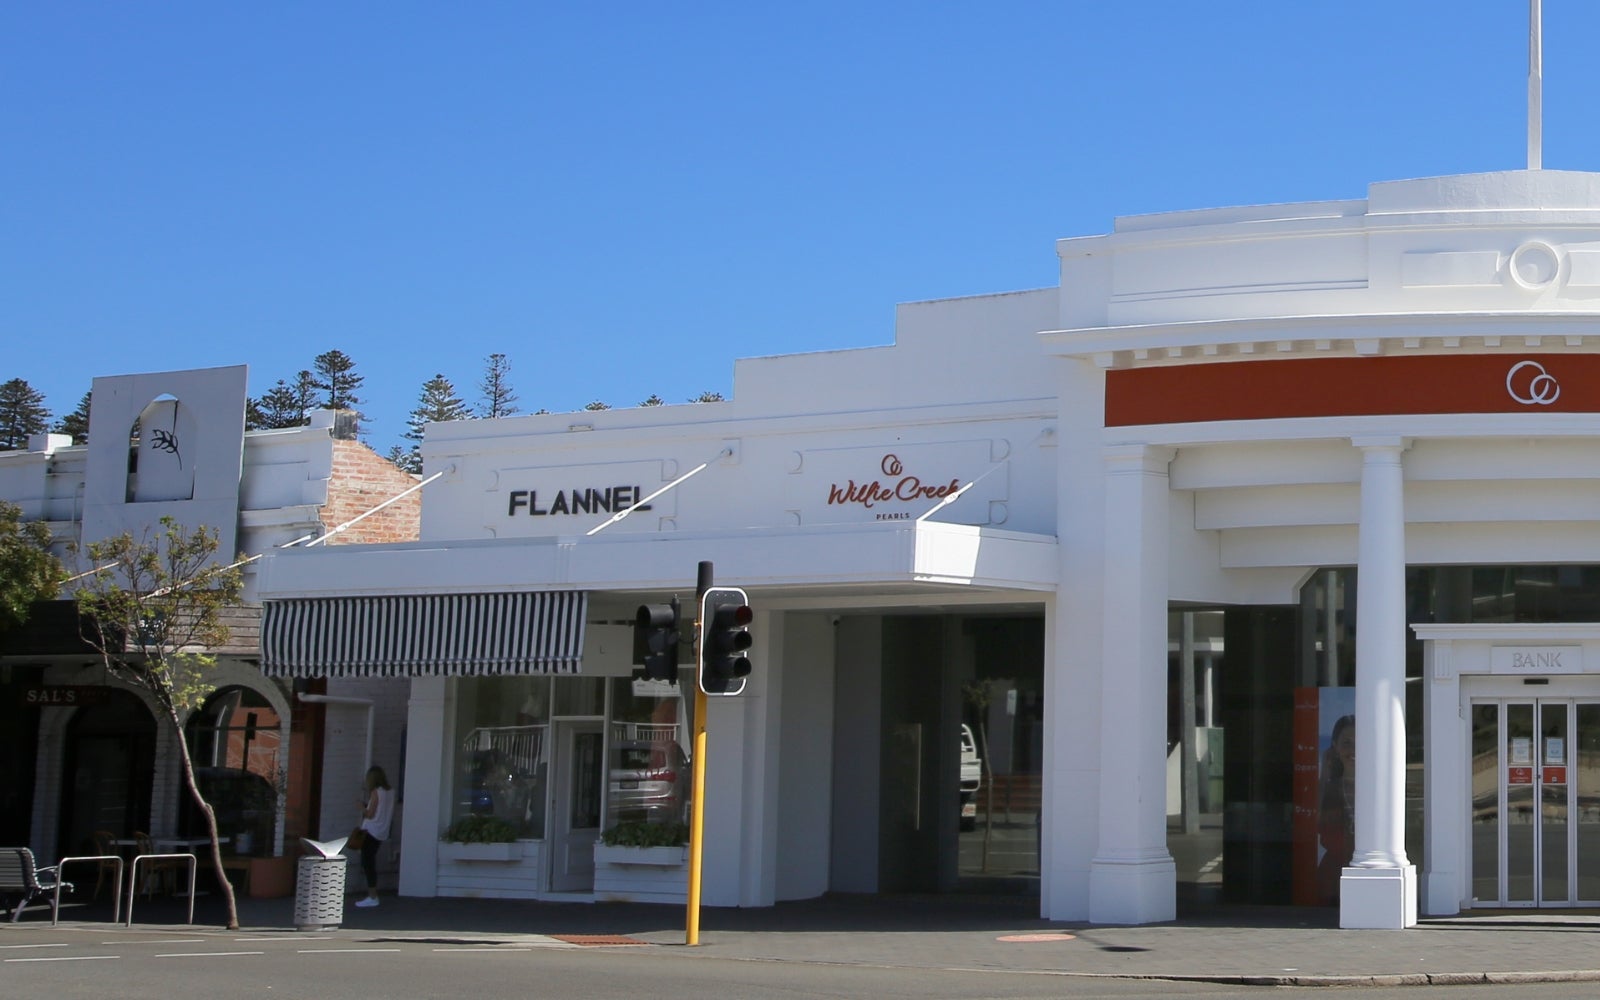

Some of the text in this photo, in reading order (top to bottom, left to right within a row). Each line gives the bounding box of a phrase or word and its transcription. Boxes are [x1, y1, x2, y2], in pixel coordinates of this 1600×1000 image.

[508, 486, 652, 517] FLANNEL
[828, 479, 894, 508] Willie
[876, 512, 910, 520] PEARLS
[1512, 652, 1562, 668] BANK
[26, 689, 76, 702] SAL'S
